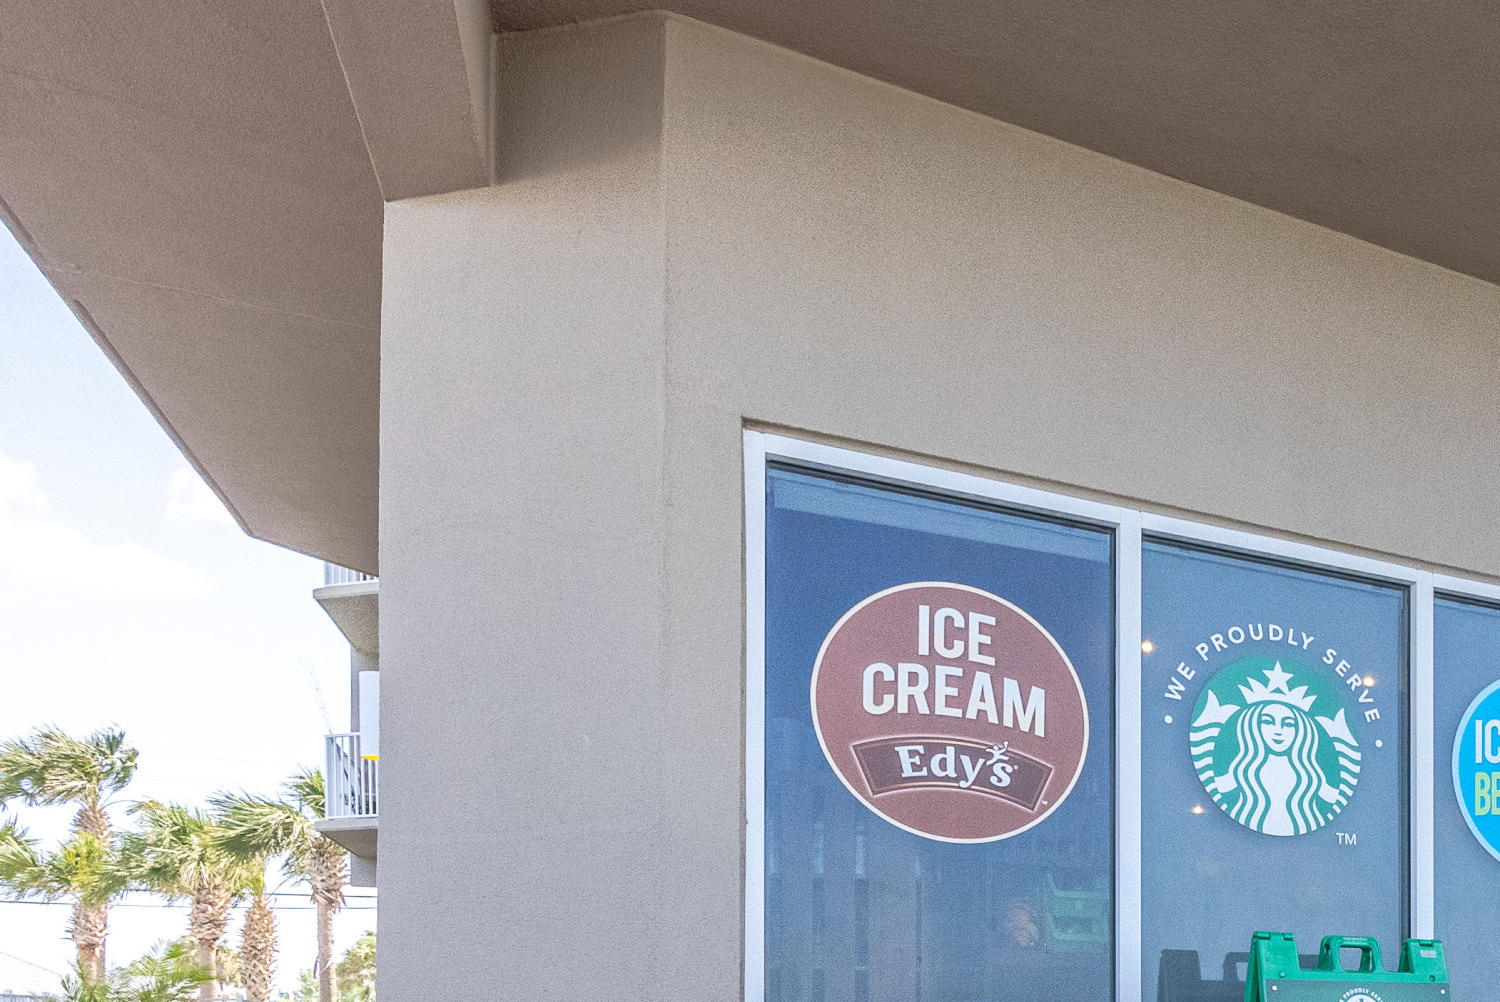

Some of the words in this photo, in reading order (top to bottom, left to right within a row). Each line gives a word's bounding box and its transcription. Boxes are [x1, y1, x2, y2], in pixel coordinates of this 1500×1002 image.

[918, 604, 997, 666] ICE
[862, 661, 1046, 737] CREAM
[1164, 660, 1196, 702] WE
[1195, 623, 1315, 661] PROUDLY
[1322, 648, 1381, 724] SERVE
[894, 740, 1016, 789] Edy's
[1335, 831, 1358, 846] TM
